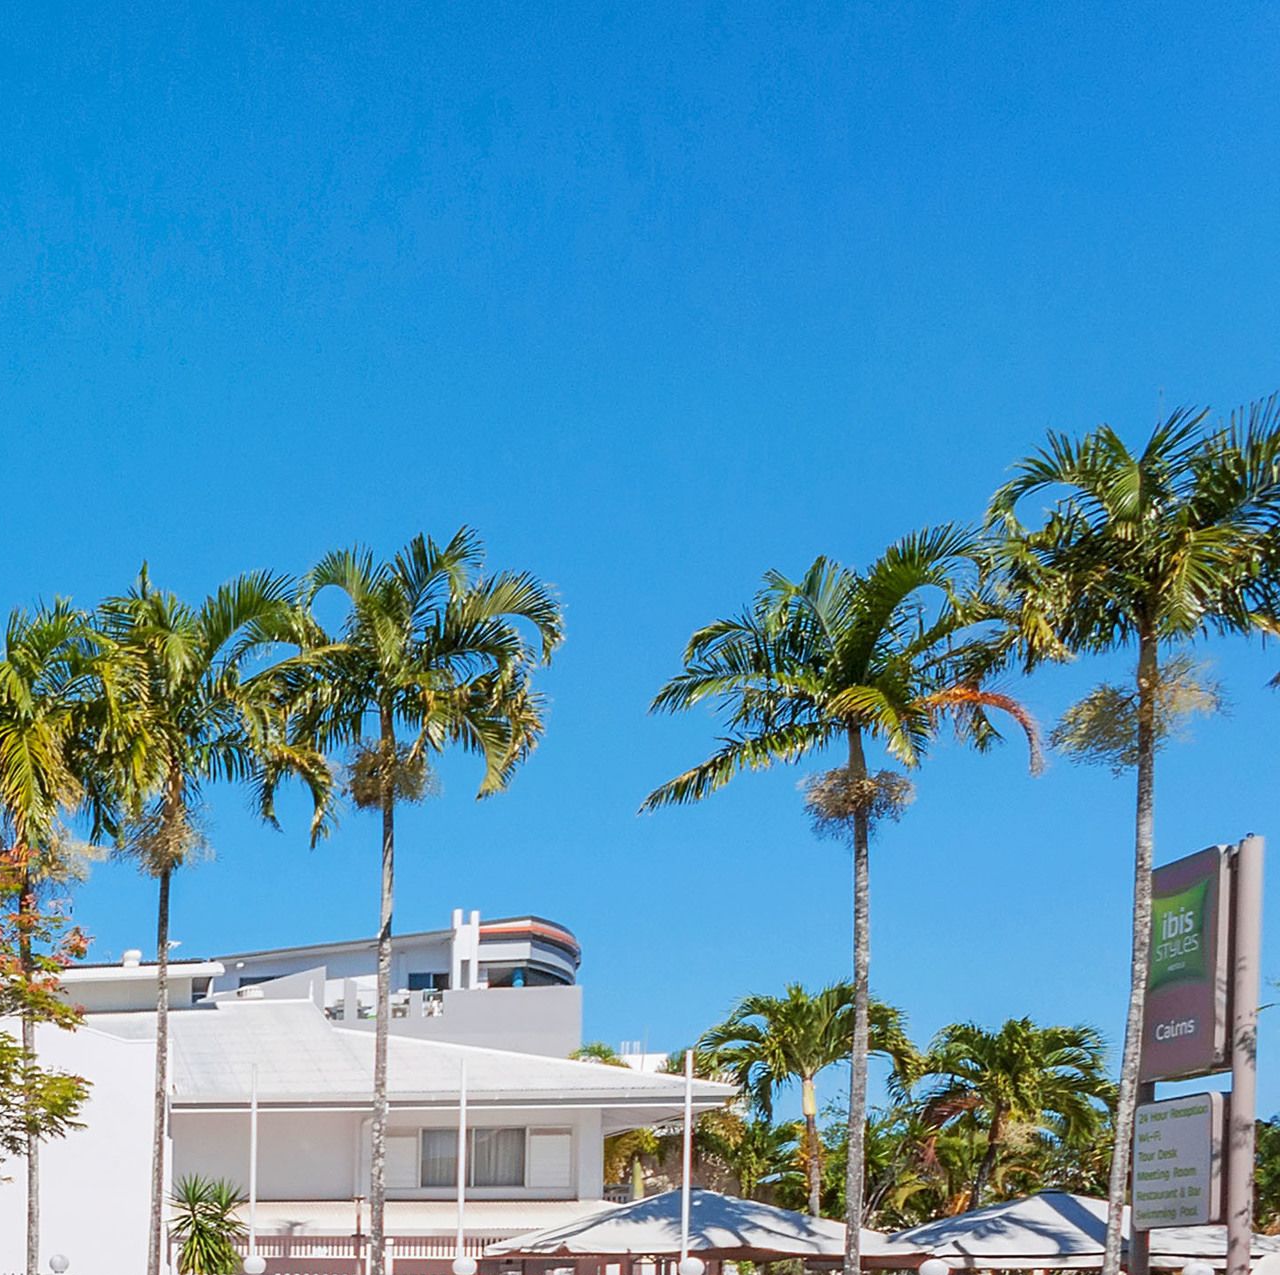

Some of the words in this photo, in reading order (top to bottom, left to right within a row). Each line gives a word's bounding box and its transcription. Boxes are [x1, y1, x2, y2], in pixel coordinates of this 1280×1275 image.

[1162, 907, 1194, 940] ibis
[1155, 1020, 1194, 1040] Cairns
[1171, 1105, 1208, 1117] Reception
[1138, 1151, 1154, 1161] Tour
[1158, 1148, 1177, 1160] Desk
[1137, 1169, 1169, 1181] Meeting
[1173, 1166, 1196, 1177] Room
[1137, 1189, 1177, 1200] Restaurant
[1187, 1186, 1201, 1197] Bar
